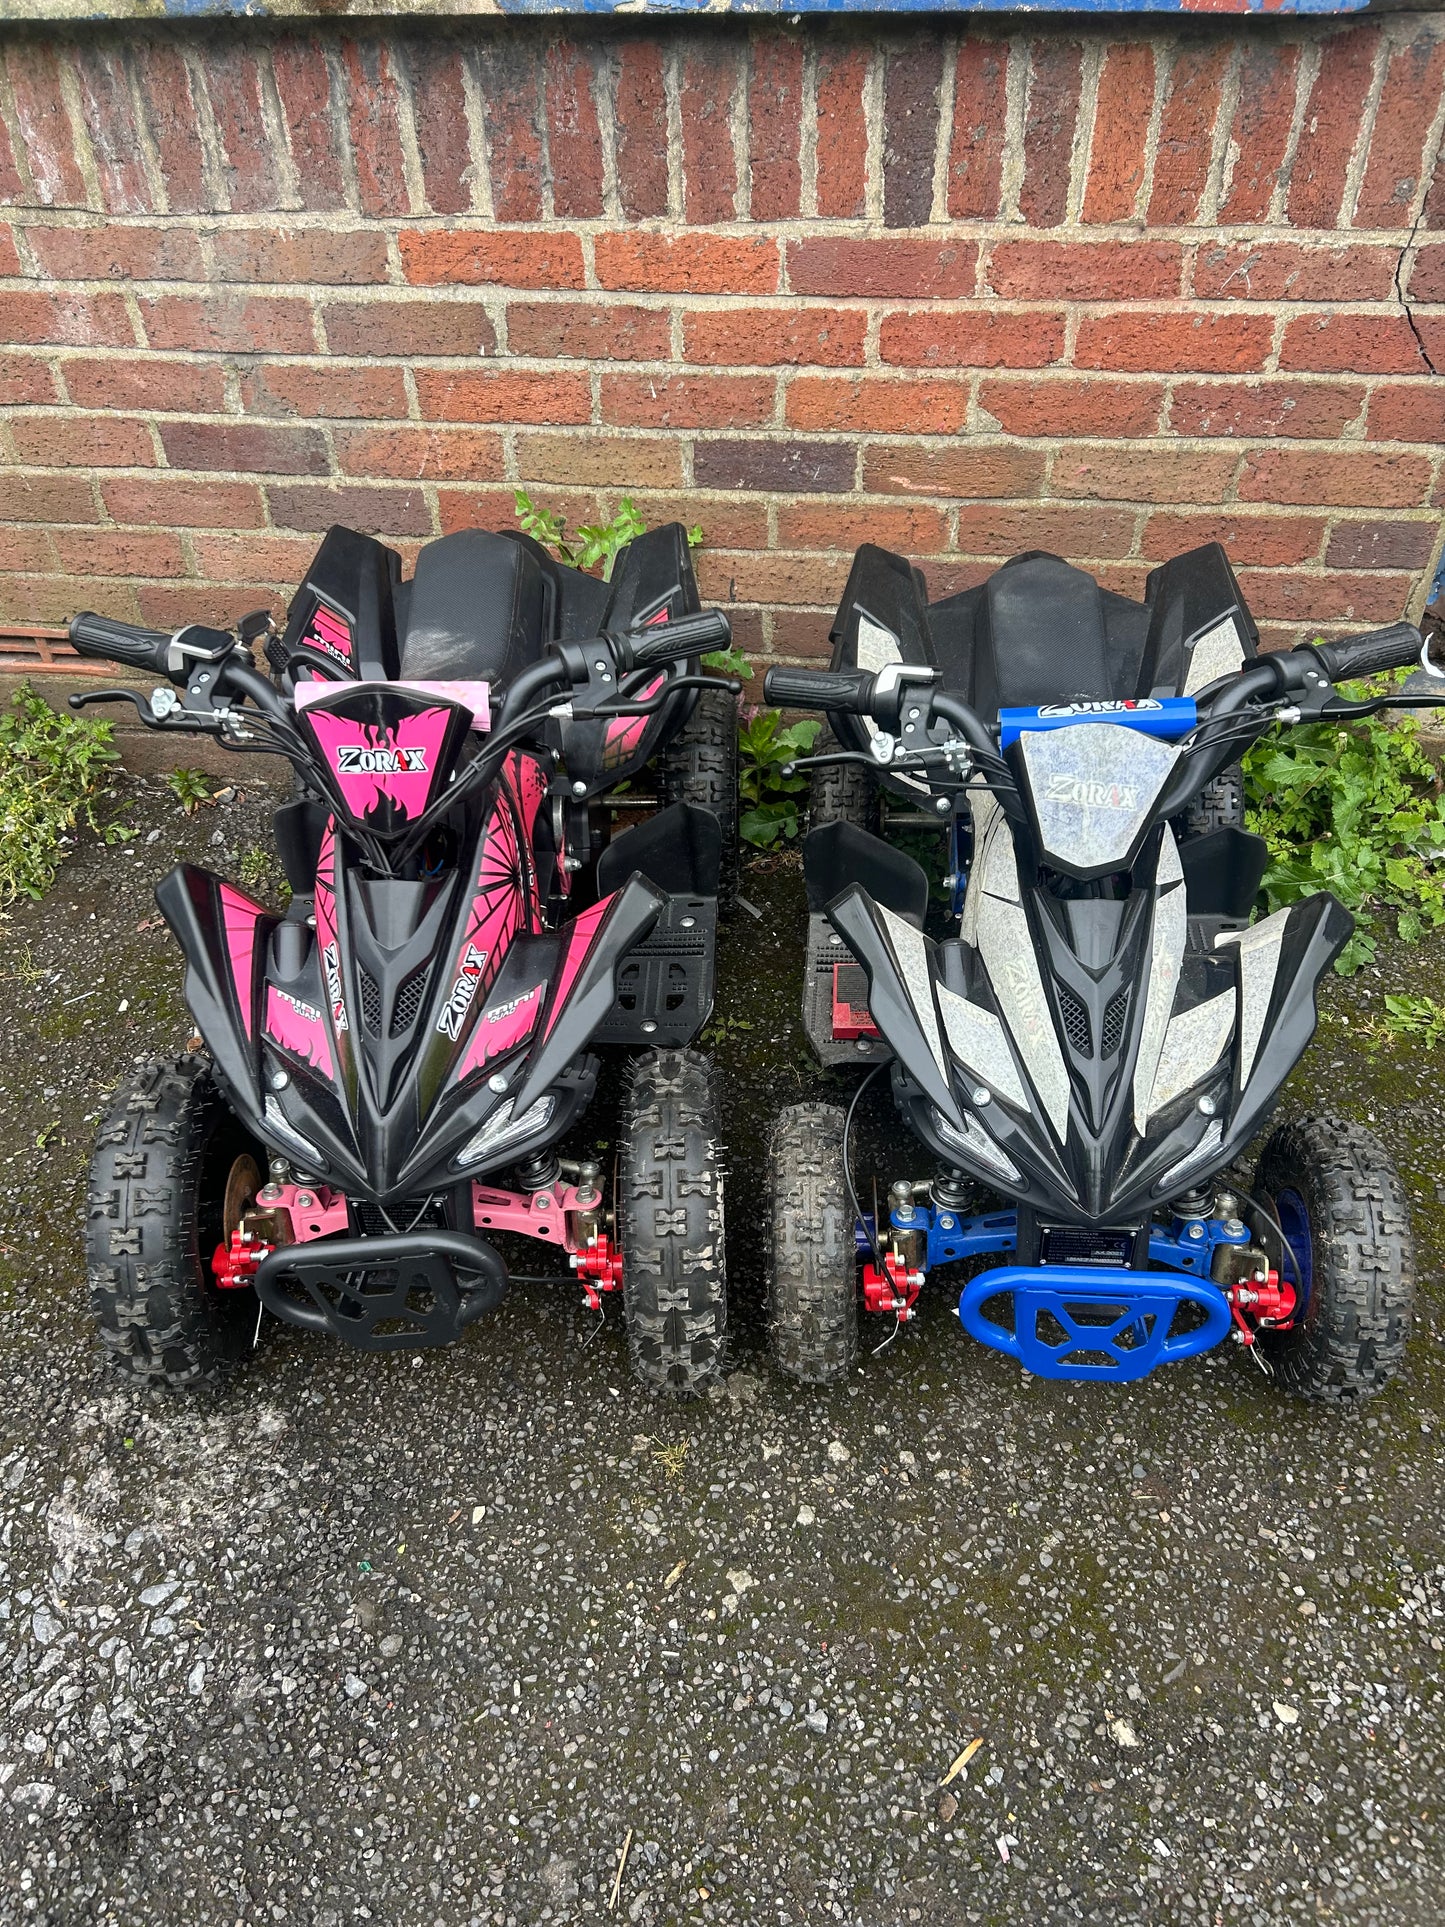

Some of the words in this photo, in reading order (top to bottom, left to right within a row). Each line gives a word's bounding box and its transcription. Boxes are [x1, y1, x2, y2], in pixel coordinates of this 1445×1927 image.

[337, 746, 428, 773] ZORAX
[1045, 773, 1138, 811] ZORAX
[323, 942, 349, 1032] ZORAX
[436, 942, 489, 1042] ZORAX
[292, 1006, 317, 1023] QUAD
[489, 1008, 516, 1023] QUAD
